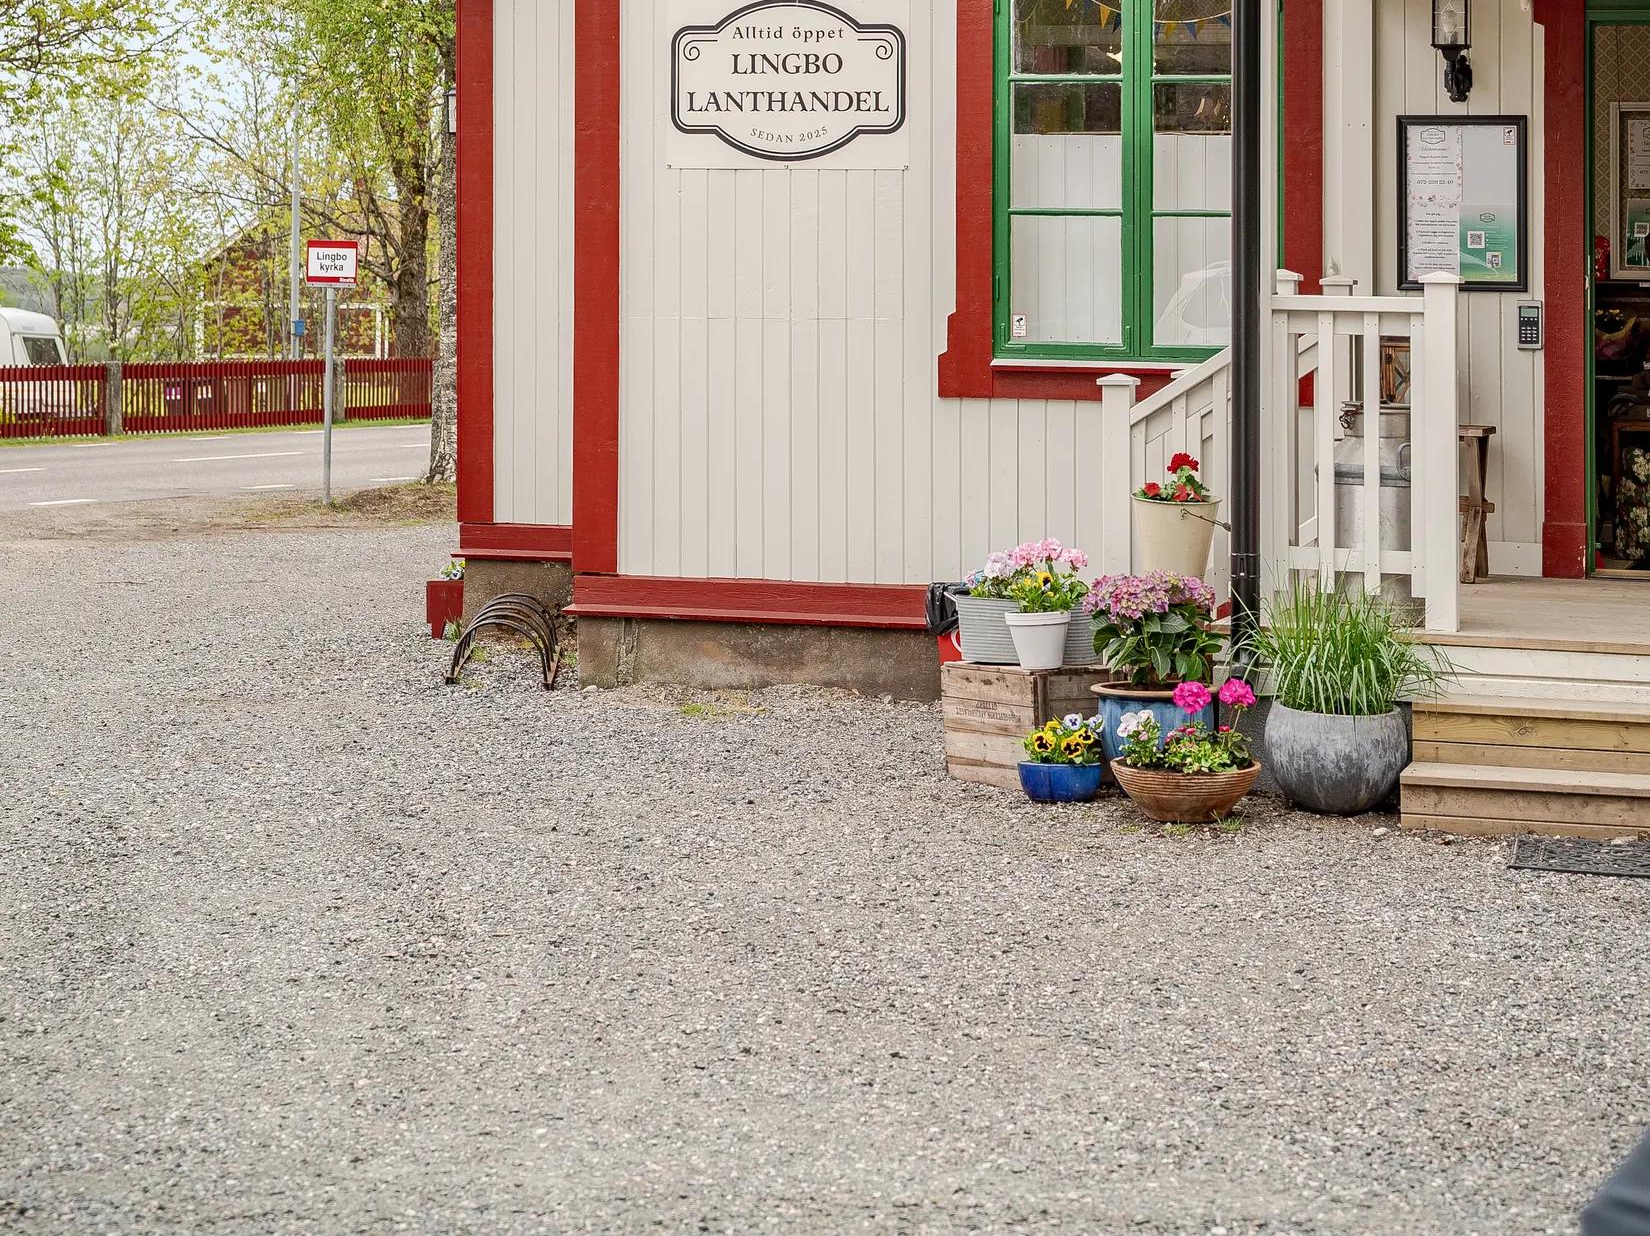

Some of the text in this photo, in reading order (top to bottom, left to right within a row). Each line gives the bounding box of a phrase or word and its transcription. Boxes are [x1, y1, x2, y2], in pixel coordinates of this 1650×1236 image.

[732, 26, 844, 43] Alltid öppet
[731, 53, 843, 74] LINGBO
[687, 91, 890, 112] LANTHANDEL
[750, 126, 828, 143] SEDAN 2025
[316, 252, 347, 262] Lingbo
[319, 262, 344, 273] kyrka
